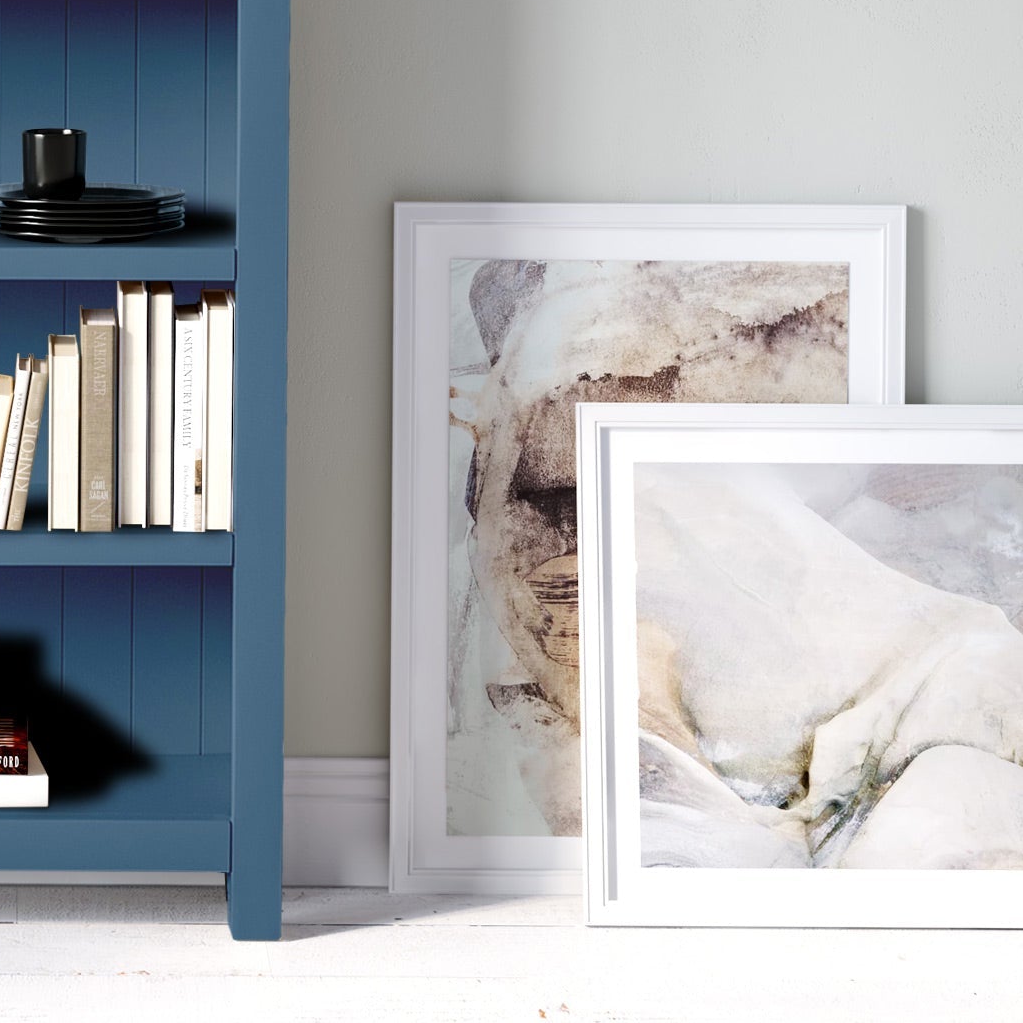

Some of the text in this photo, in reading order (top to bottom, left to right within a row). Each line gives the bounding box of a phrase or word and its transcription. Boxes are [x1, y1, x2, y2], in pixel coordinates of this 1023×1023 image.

[184, 336, 193, 354] SIX
[183, 355, 193, 406] CENTURY
[182, 408, 192, 448] FAMILY
[4, 435, 18, 479] CEREAL
[14, 418, 40, 492] KINFOLK
